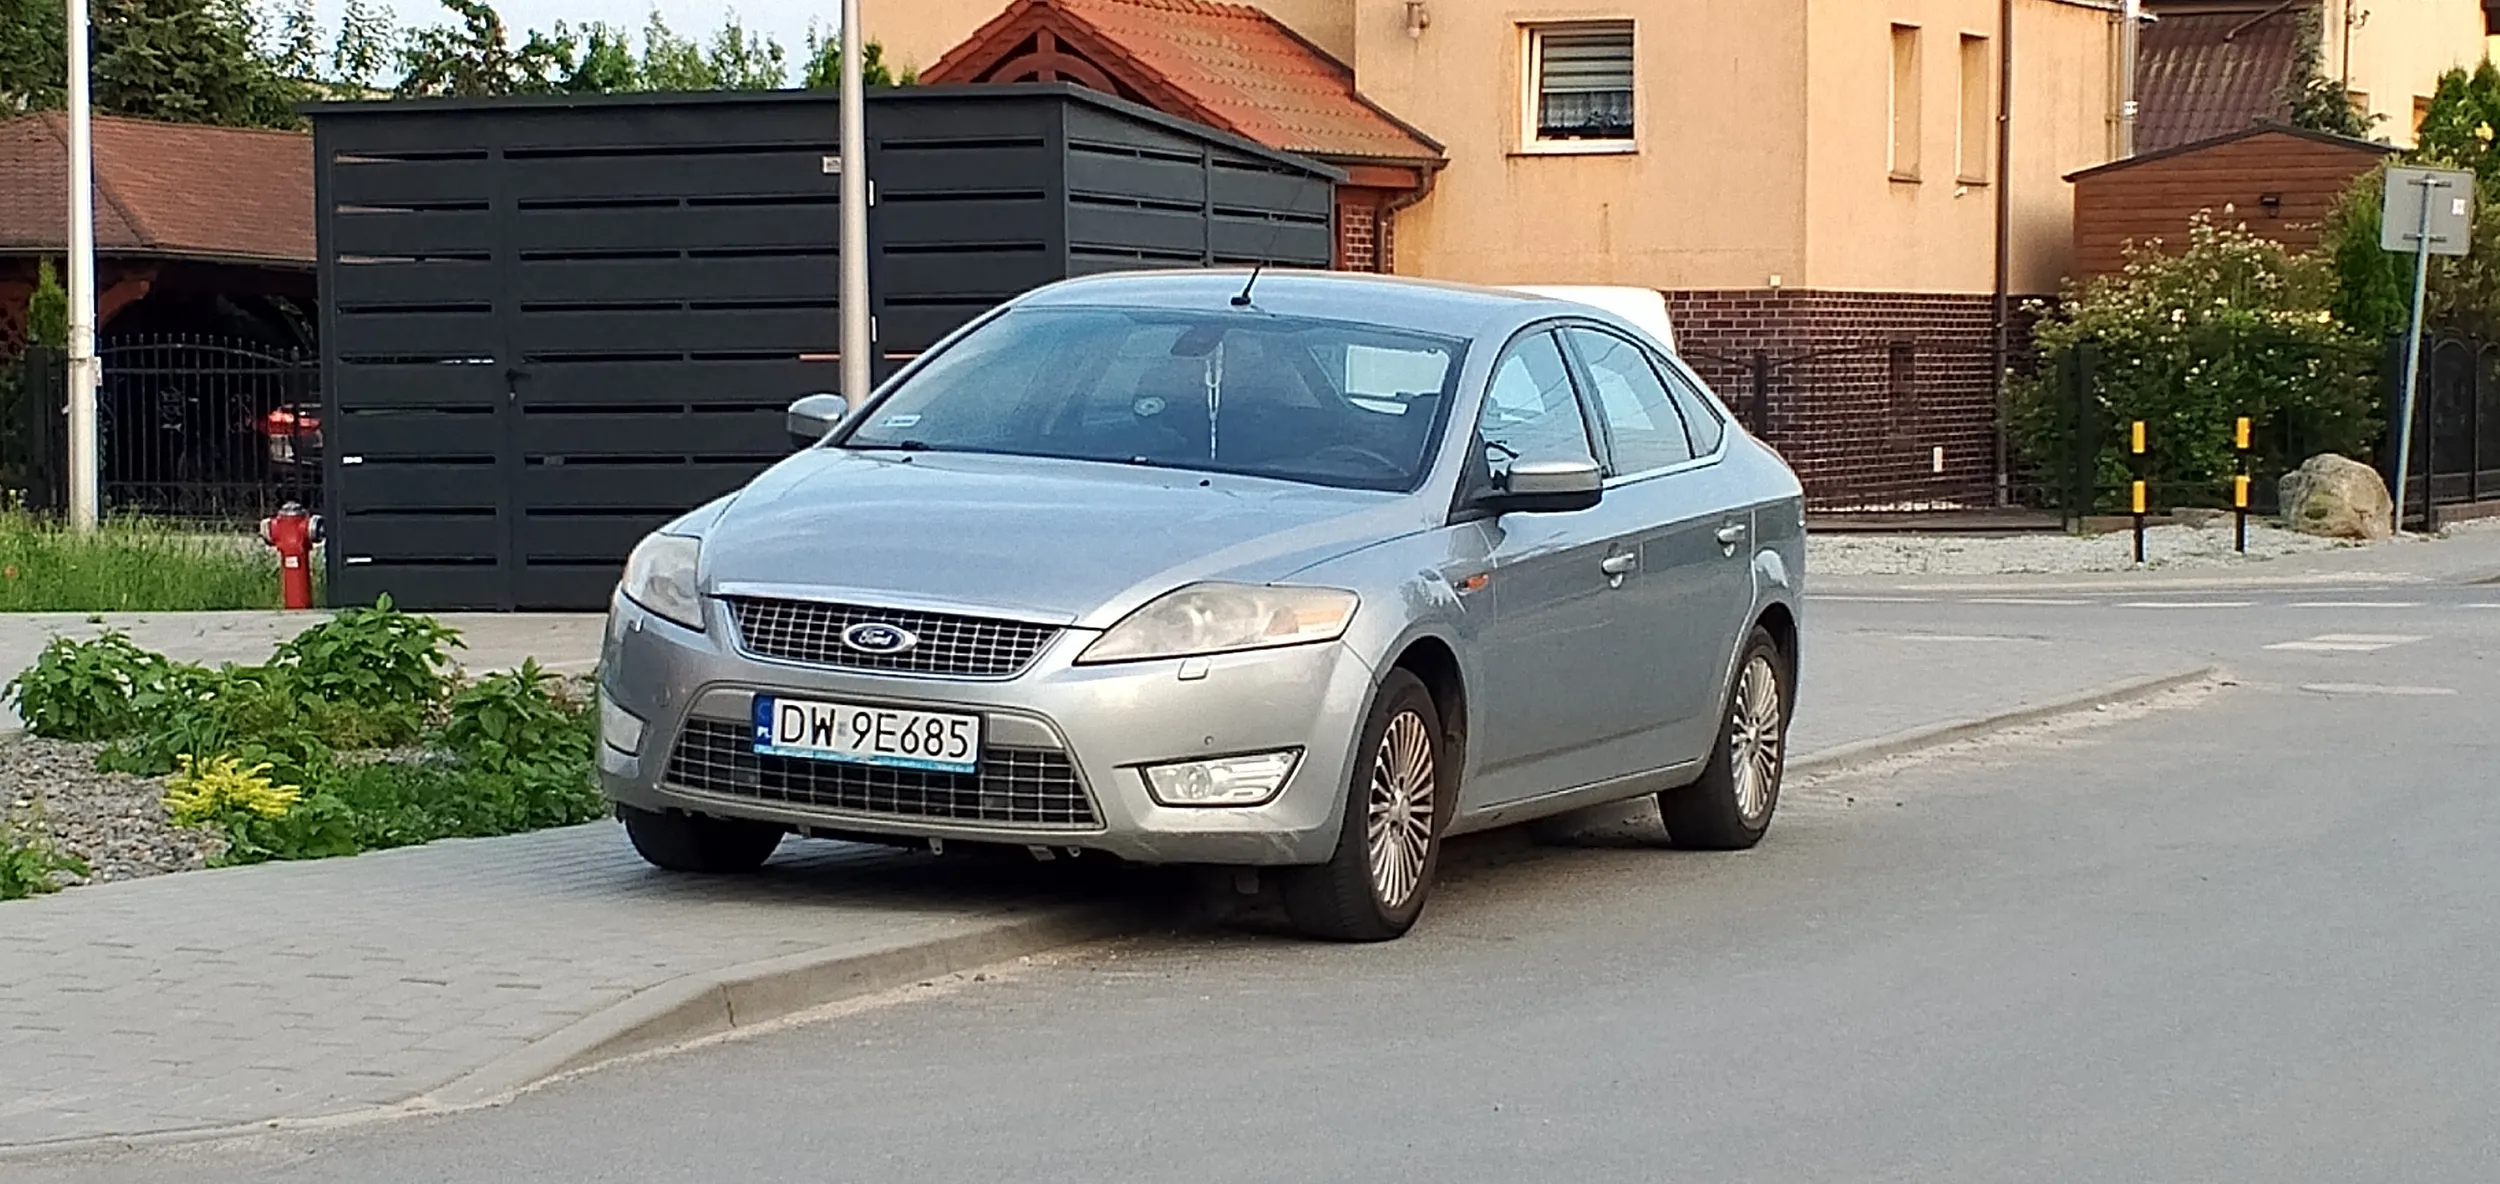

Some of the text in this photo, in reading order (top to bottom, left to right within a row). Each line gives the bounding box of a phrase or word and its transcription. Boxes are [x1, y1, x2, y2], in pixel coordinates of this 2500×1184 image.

[858, 629, 893, 646] Ford
[757, 726, 773, 739] PL
[780, 704, 969, 758] DW 9E685
